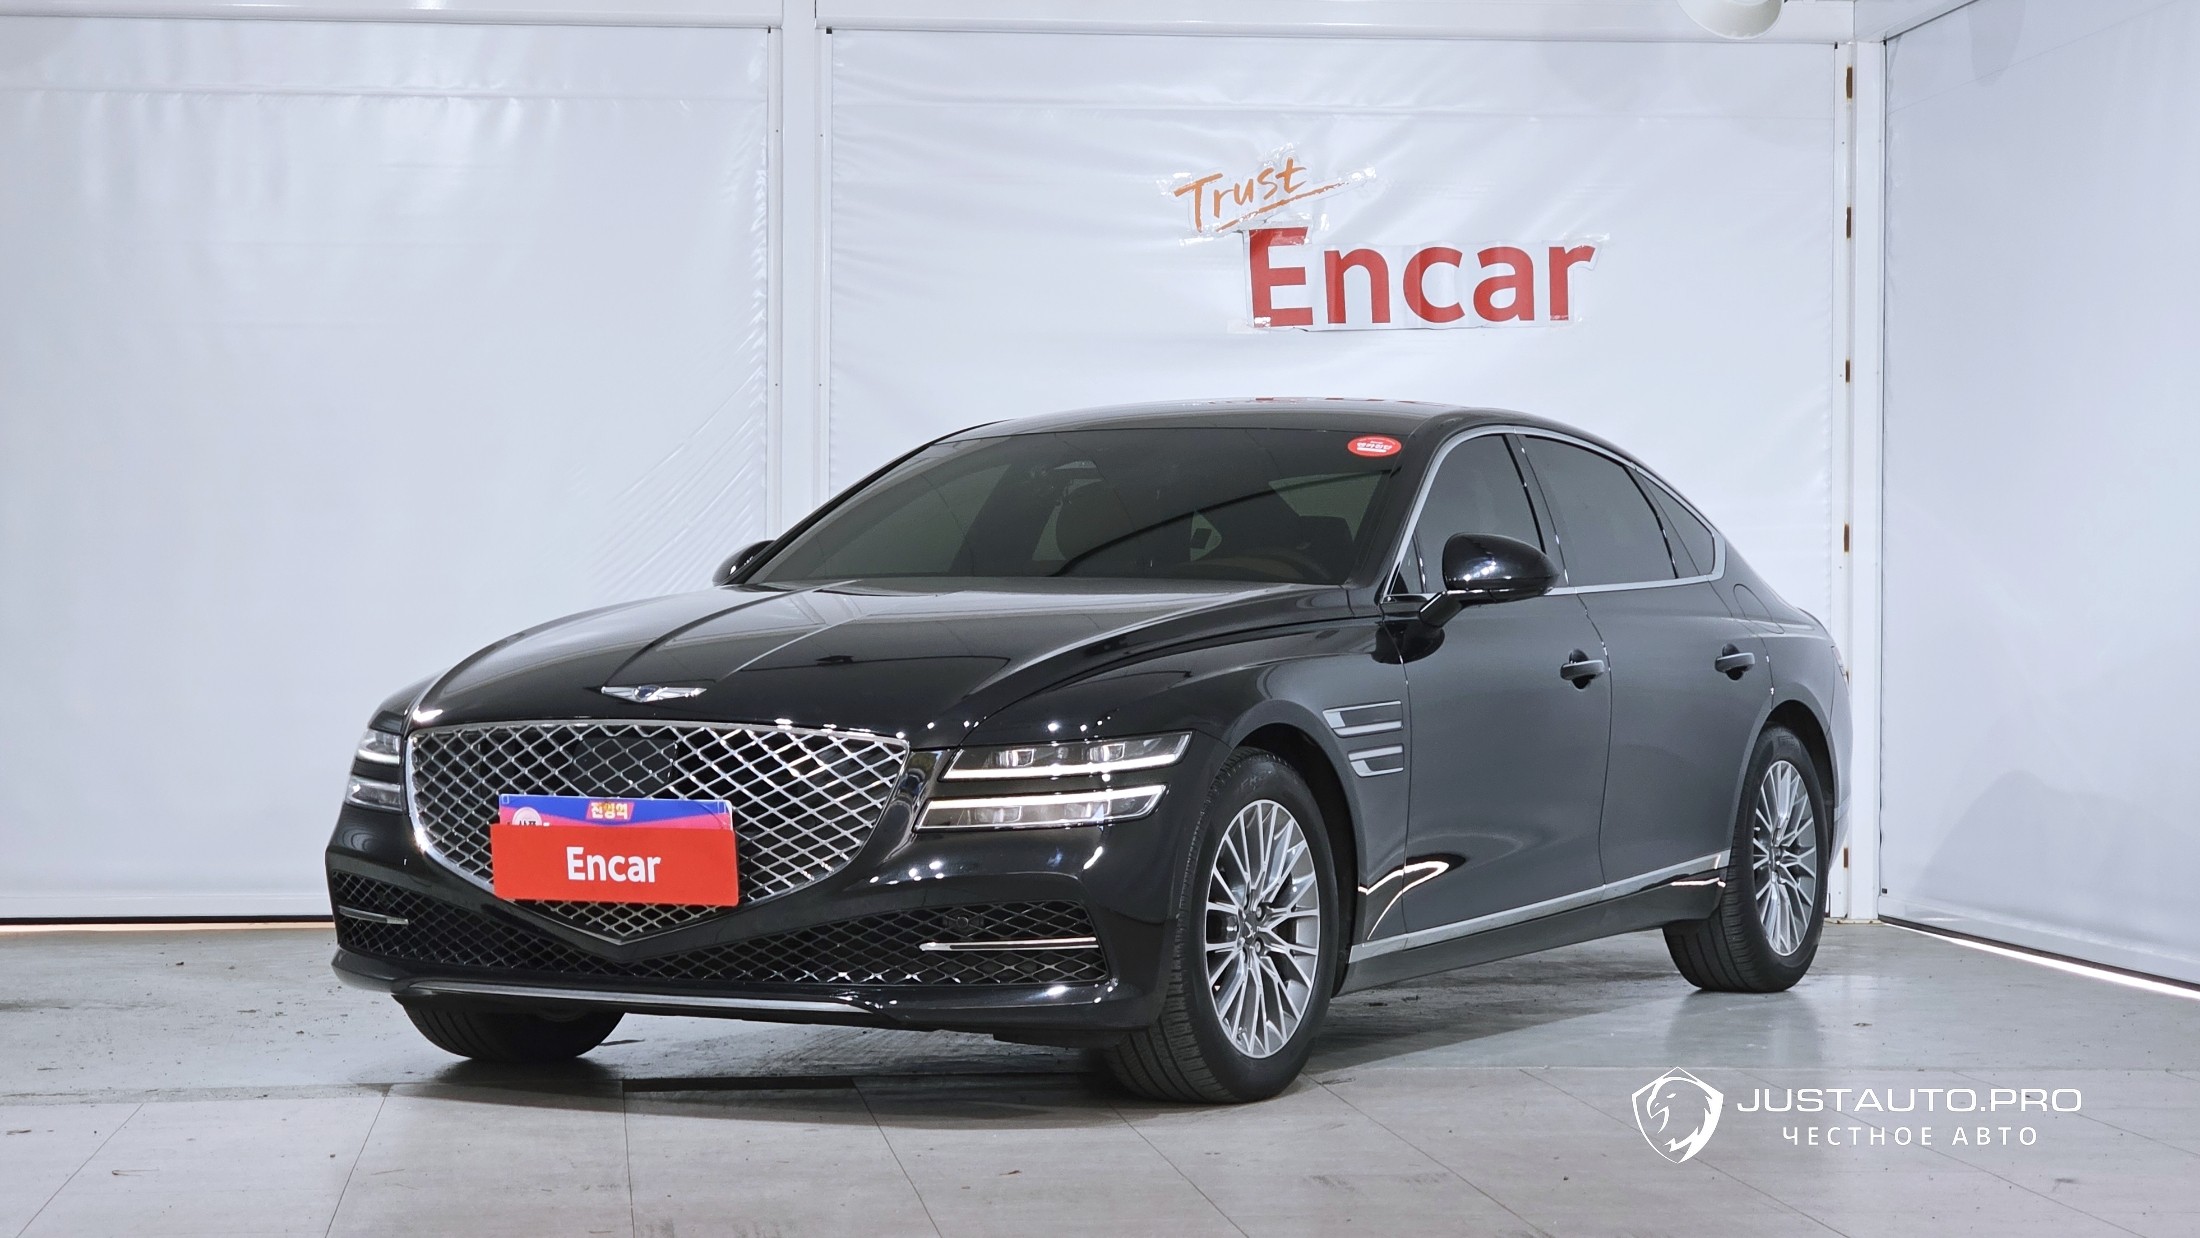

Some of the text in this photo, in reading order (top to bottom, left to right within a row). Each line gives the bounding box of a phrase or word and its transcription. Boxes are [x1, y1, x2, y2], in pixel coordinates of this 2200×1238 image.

[1174, 157, 1308, 233] Trust
[1248, 227, 1596, 327] Encar
[566, 846, 661, 883] Encar
